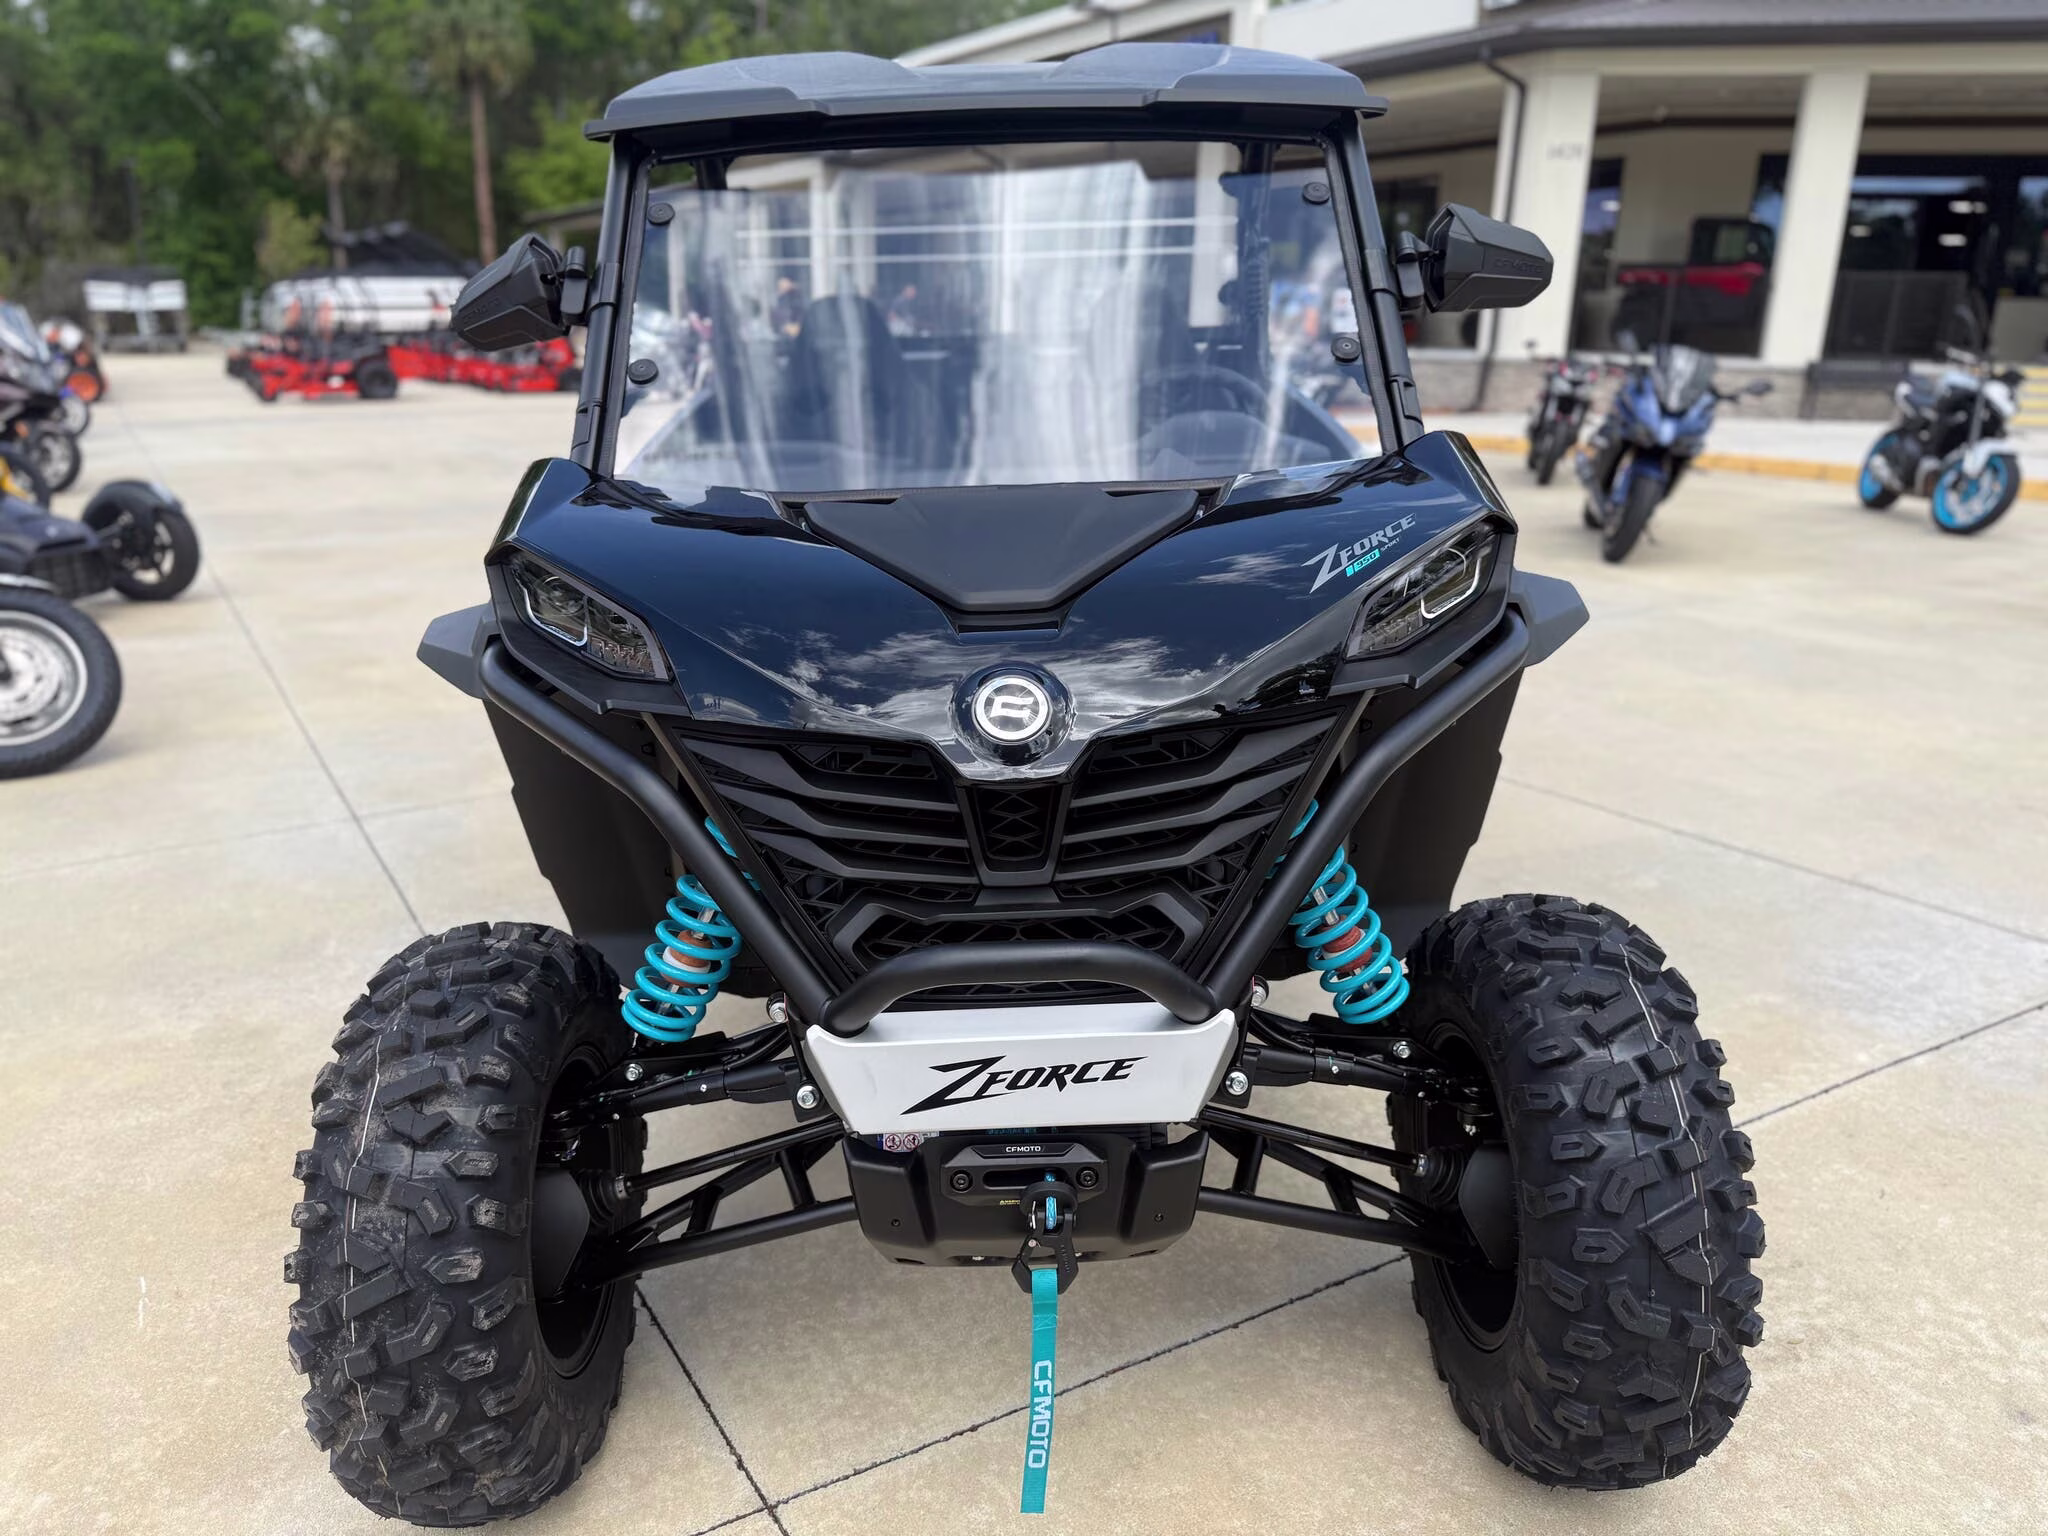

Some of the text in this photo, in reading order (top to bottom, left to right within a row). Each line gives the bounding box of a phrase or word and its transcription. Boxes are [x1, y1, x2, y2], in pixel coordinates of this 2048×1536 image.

[1301, 513, 1416, 594] ZFORCE
[1355, 537, 1400, 570] 950 SPORT
[900, 1055, 1148, 1115] ZFORCE
[1005, 1145, 1041, 1153] CFMOTO
[1028, 1359, 1052, 1468] CFMOTO
